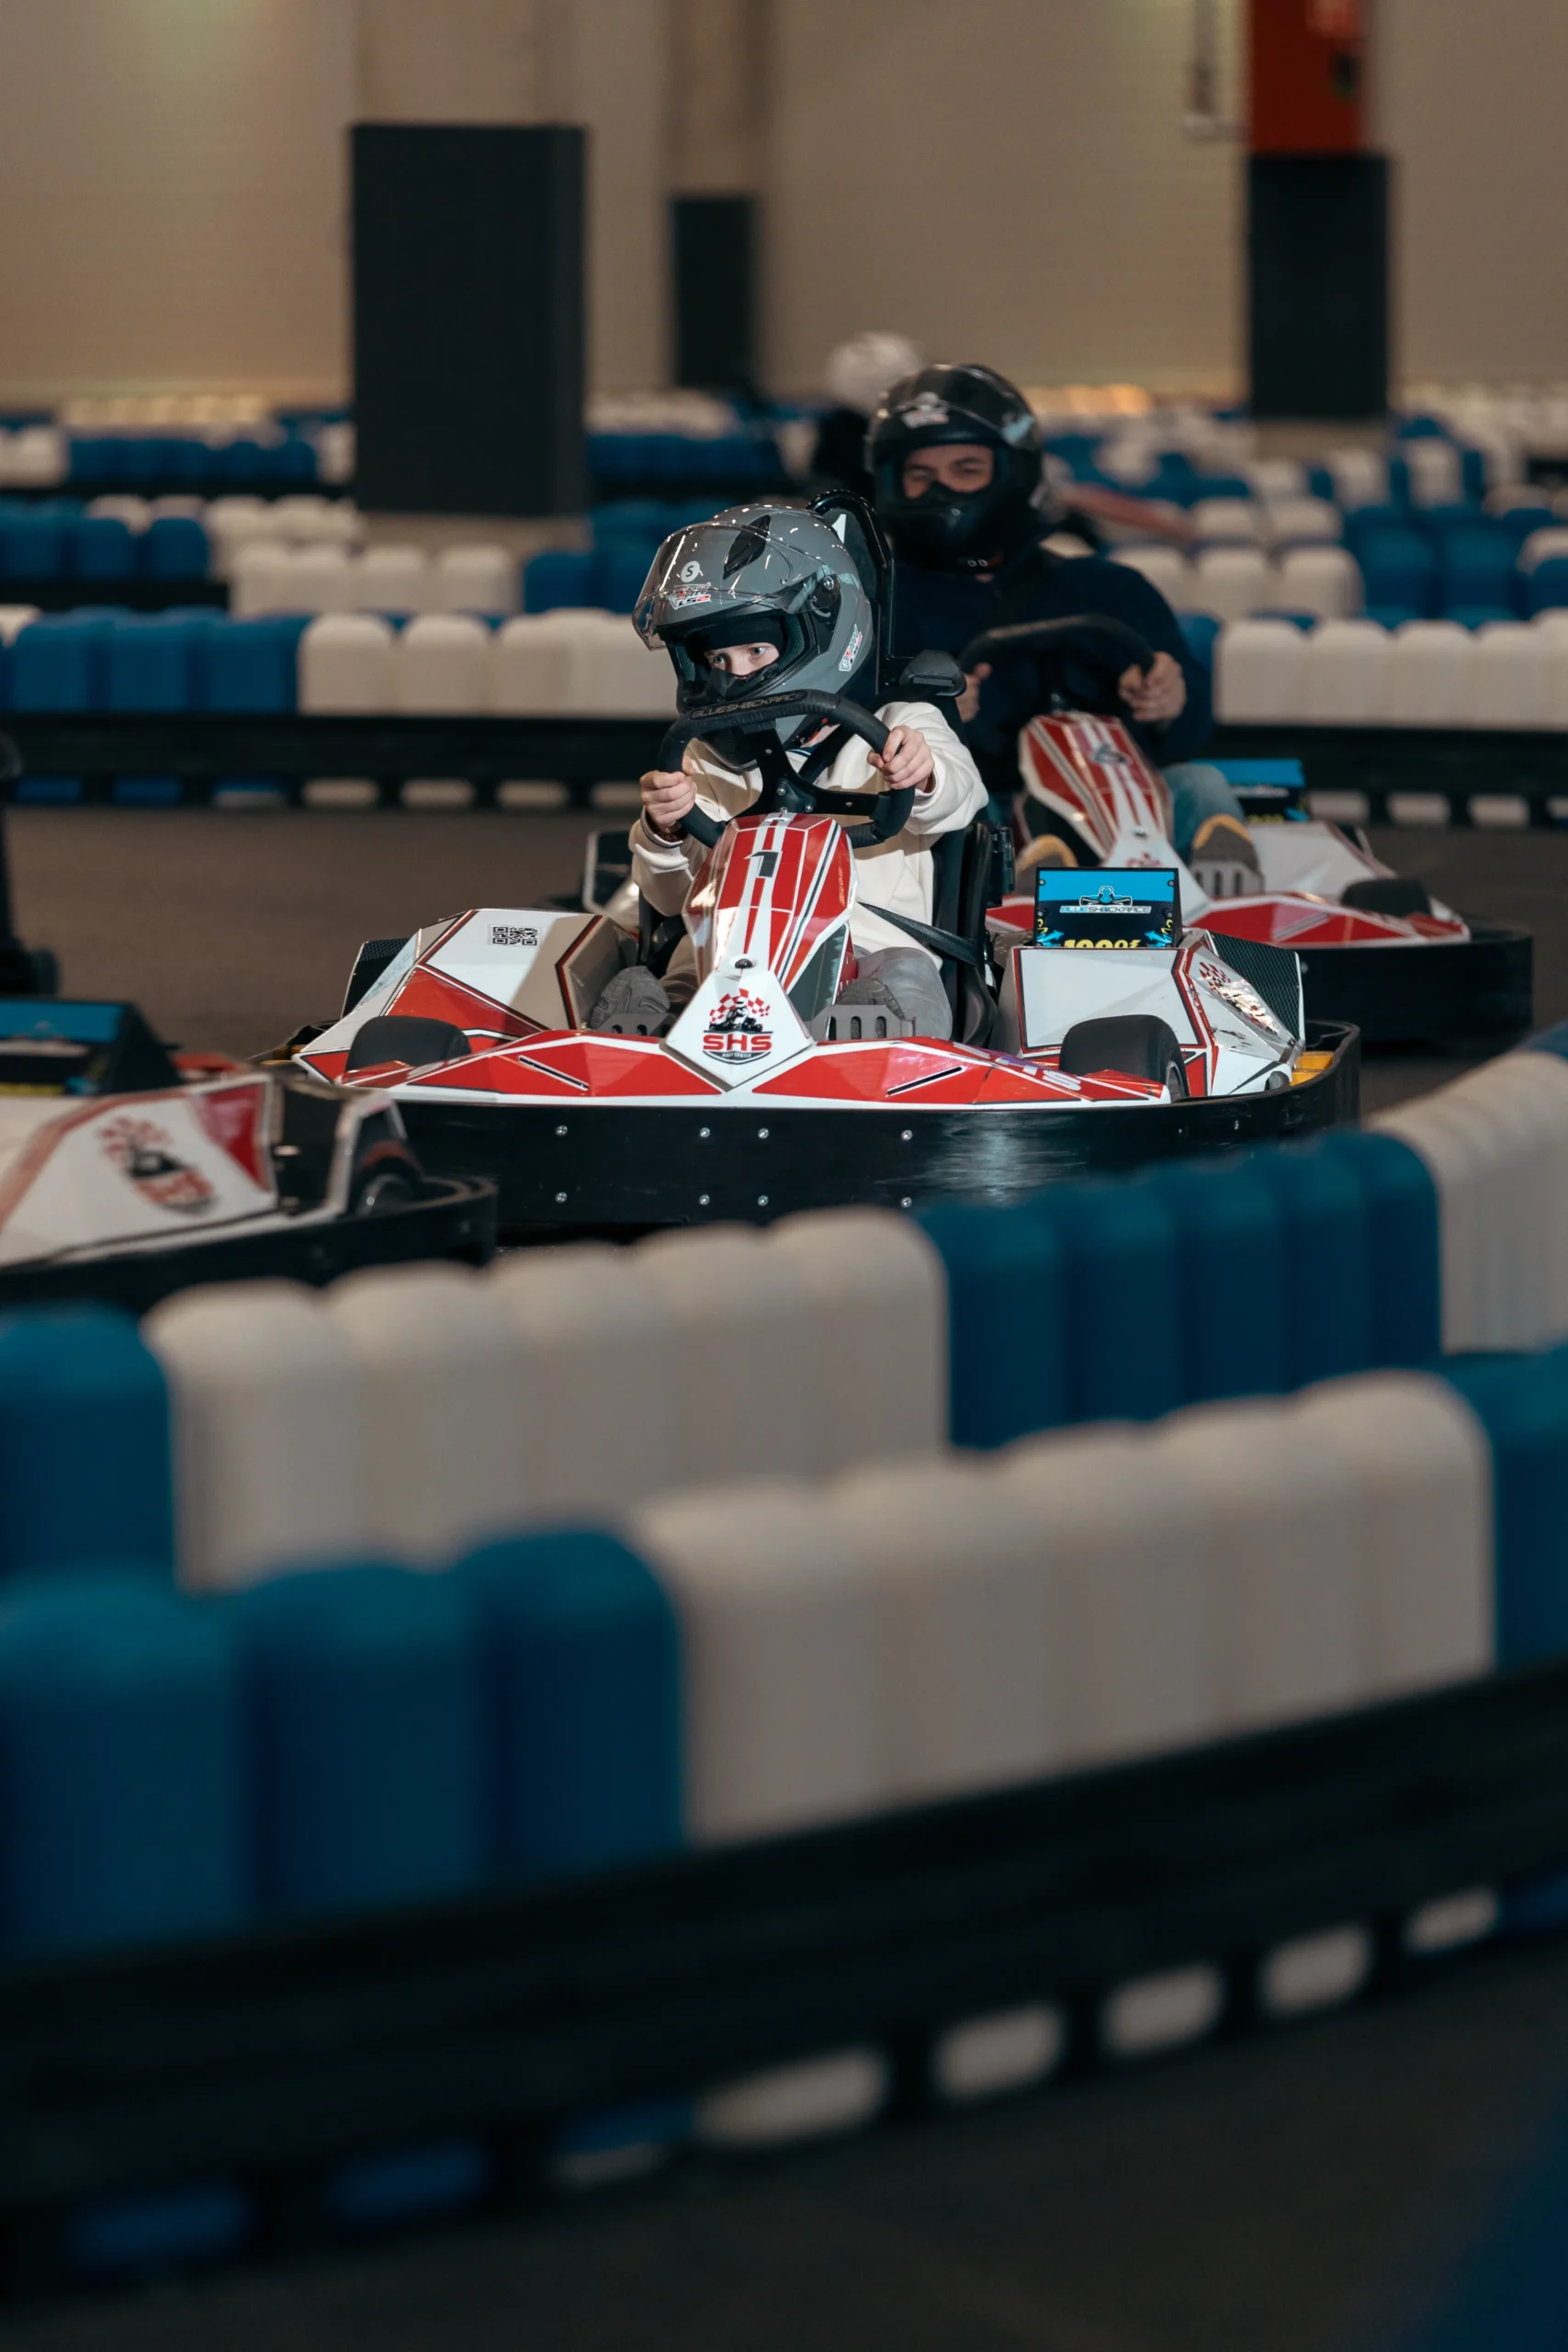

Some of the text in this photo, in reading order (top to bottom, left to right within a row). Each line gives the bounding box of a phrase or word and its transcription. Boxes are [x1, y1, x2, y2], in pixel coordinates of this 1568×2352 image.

[685, 565, 694, 578] S
[750, 851, 780, 878] 1
[703, 1033, 773, 1051] SHS
